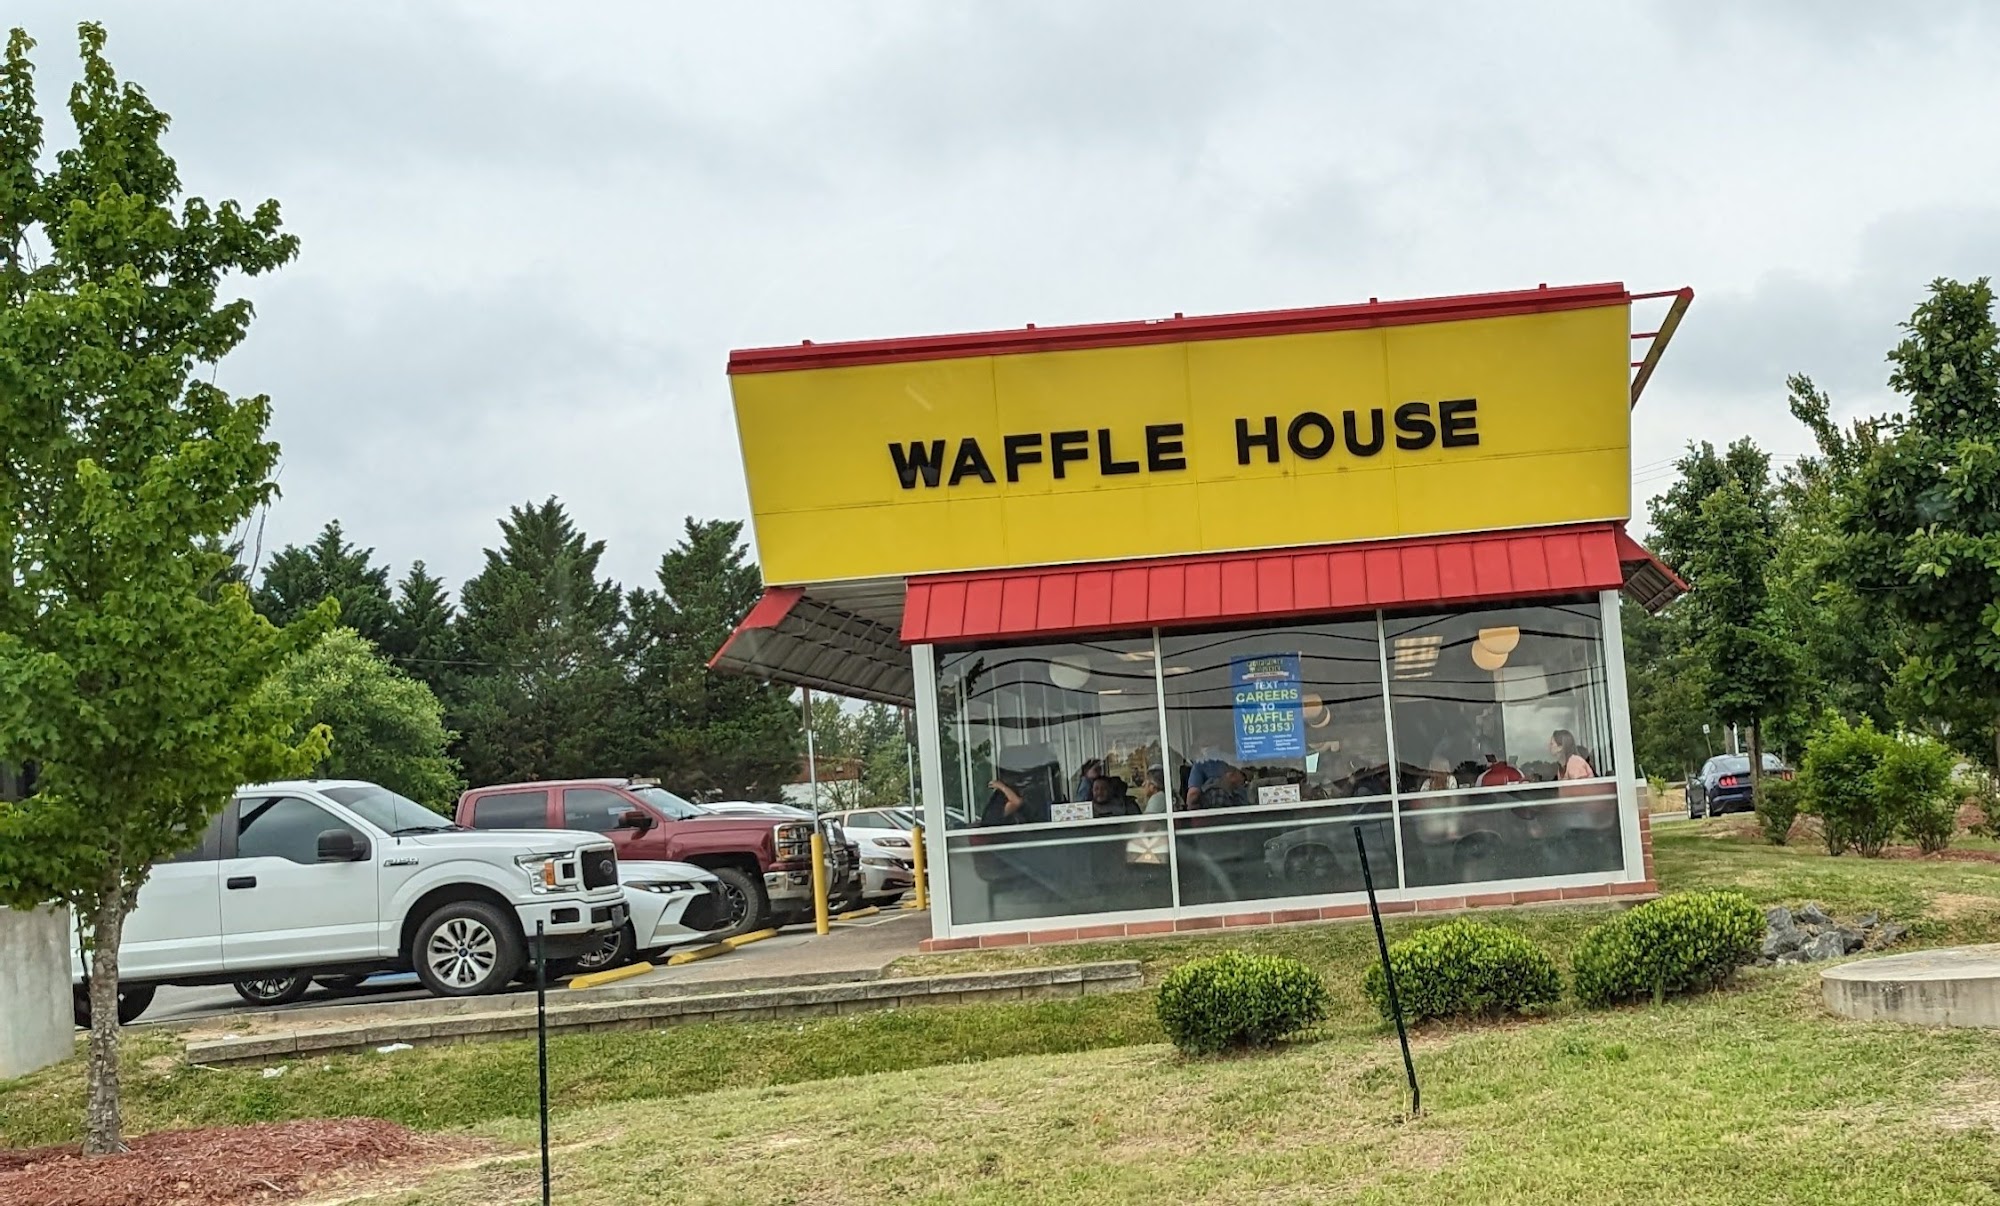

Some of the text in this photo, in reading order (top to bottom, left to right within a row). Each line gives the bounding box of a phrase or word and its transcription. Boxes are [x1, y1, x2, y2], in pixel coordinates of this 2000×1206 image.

[888, 398, 1480, 490] WAFFLE HOUSE
[1254, 681, 1278, 690] TEXT
[1236, 689, 1298, 703] CAREERS
[1260, 702, 1275, 711] TO
[1242, 710, 1294, 724] WAFFLE
[1244, 722, 1295, 735] (923353)
